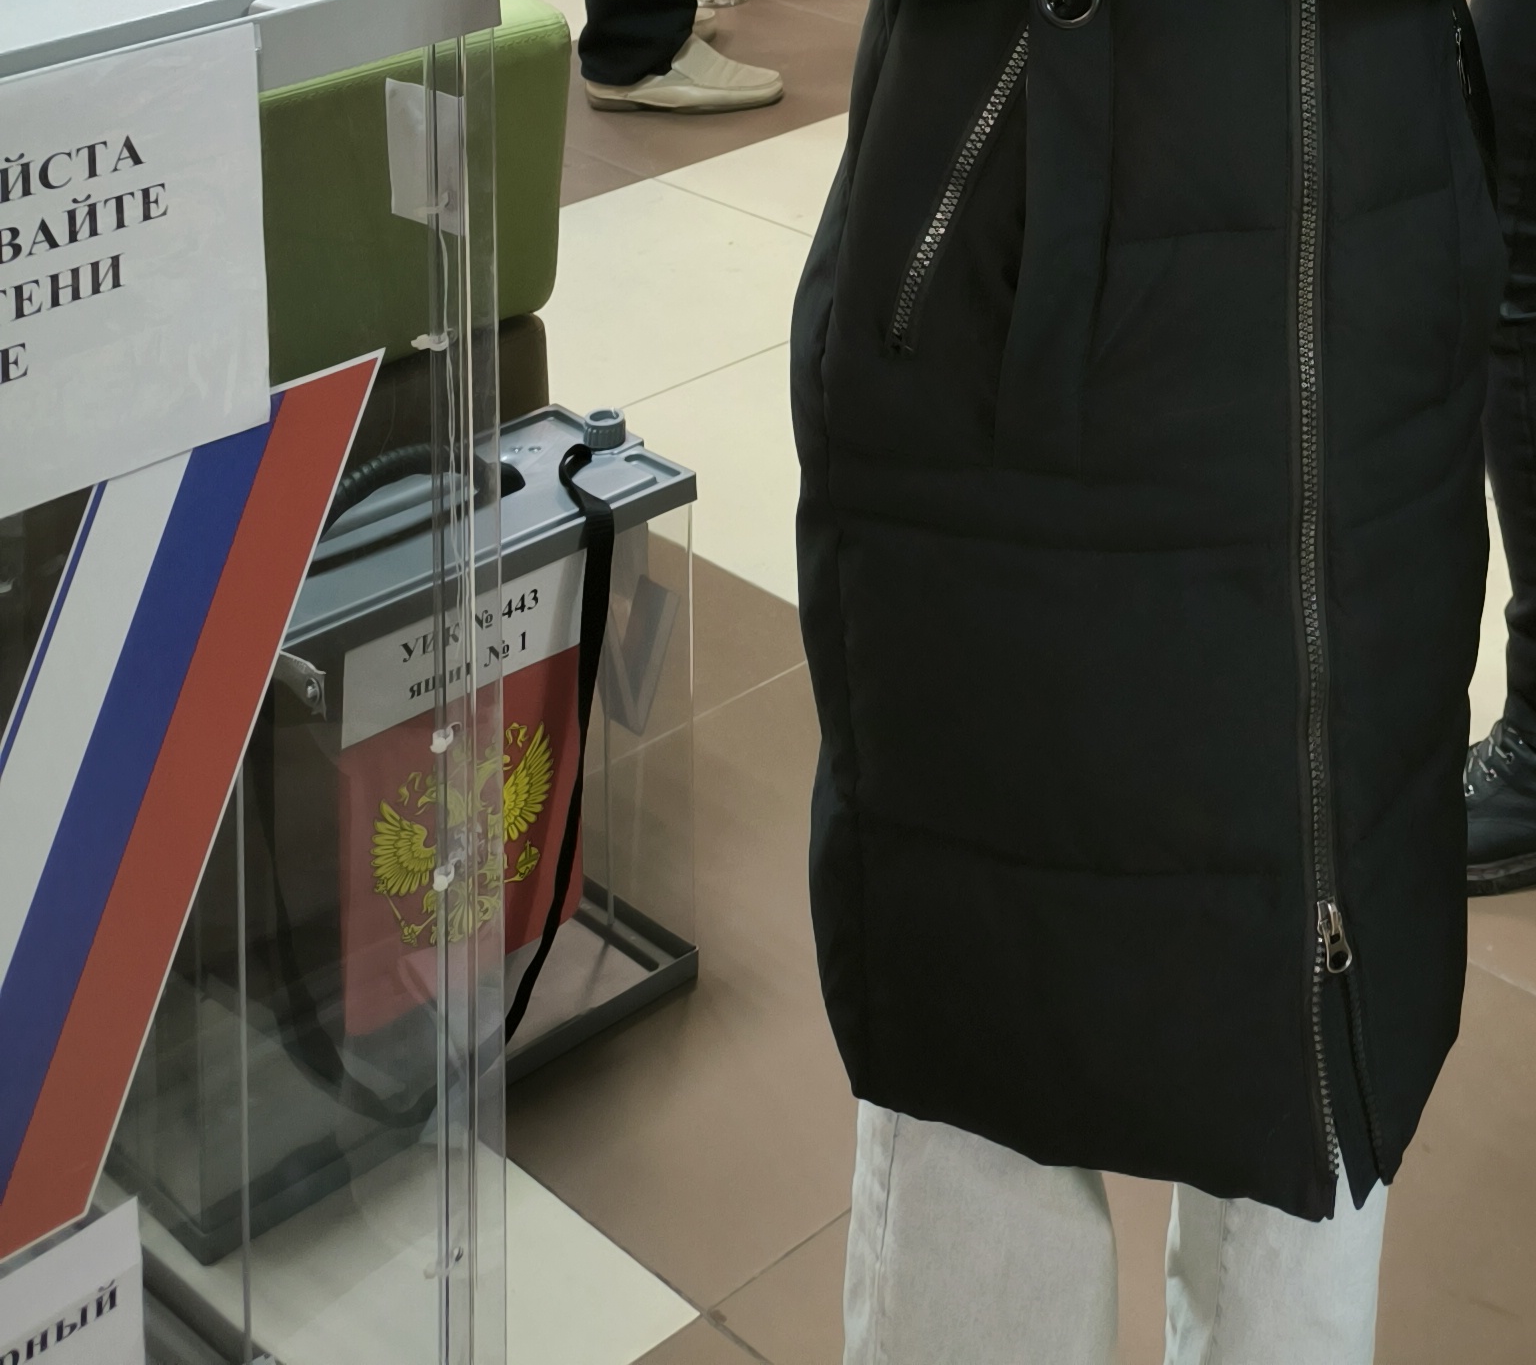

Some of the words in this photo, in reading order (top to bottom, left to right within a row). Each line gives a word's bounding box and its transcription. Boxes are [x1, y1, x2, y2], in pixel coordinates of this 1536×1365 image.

[0, 134, 146, 204] ЙСТА
[0, 182, 169, 265] ВАЙТЕ
[474, 609, 493, 630] №
[501, 588, 539, 619] 443
[483, 639, 510, 668] №
[518, 630, 527, 653] 1
